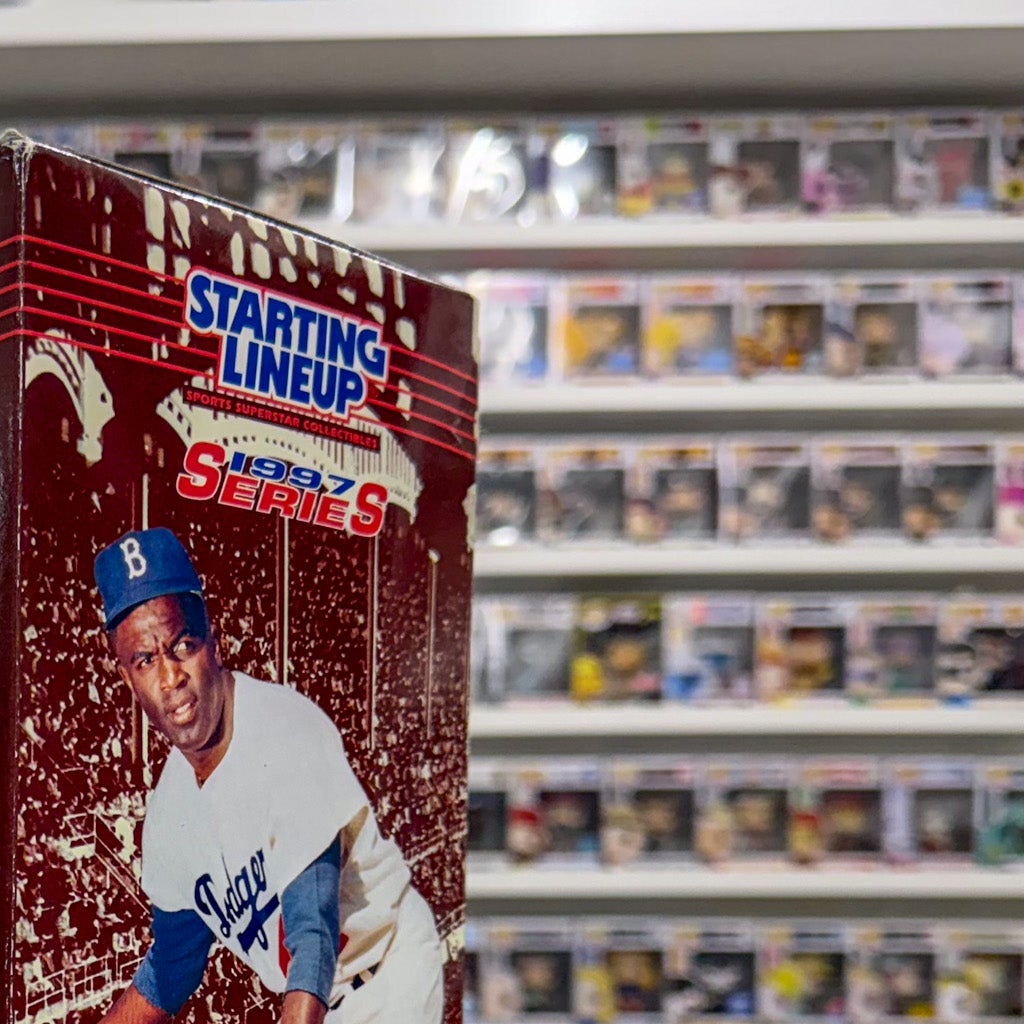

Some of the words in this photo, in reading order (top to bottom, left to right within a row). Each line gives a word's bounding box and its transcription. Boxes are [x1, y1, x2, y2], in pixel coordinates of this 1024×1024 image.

[187, 272, 387, 380] STARTING
[220, 333, 365, 418] LINEUP
[186, 390, 231, 410] SPORTS
[235, 402, 299, 427] SUPERSTAR
[303, 420, 377, 449] COLLECTIBLES
[176, 441, 389, 538] SERIES
[229, 451, 356, 496] 1997
[119, 536, 147, 580] B
